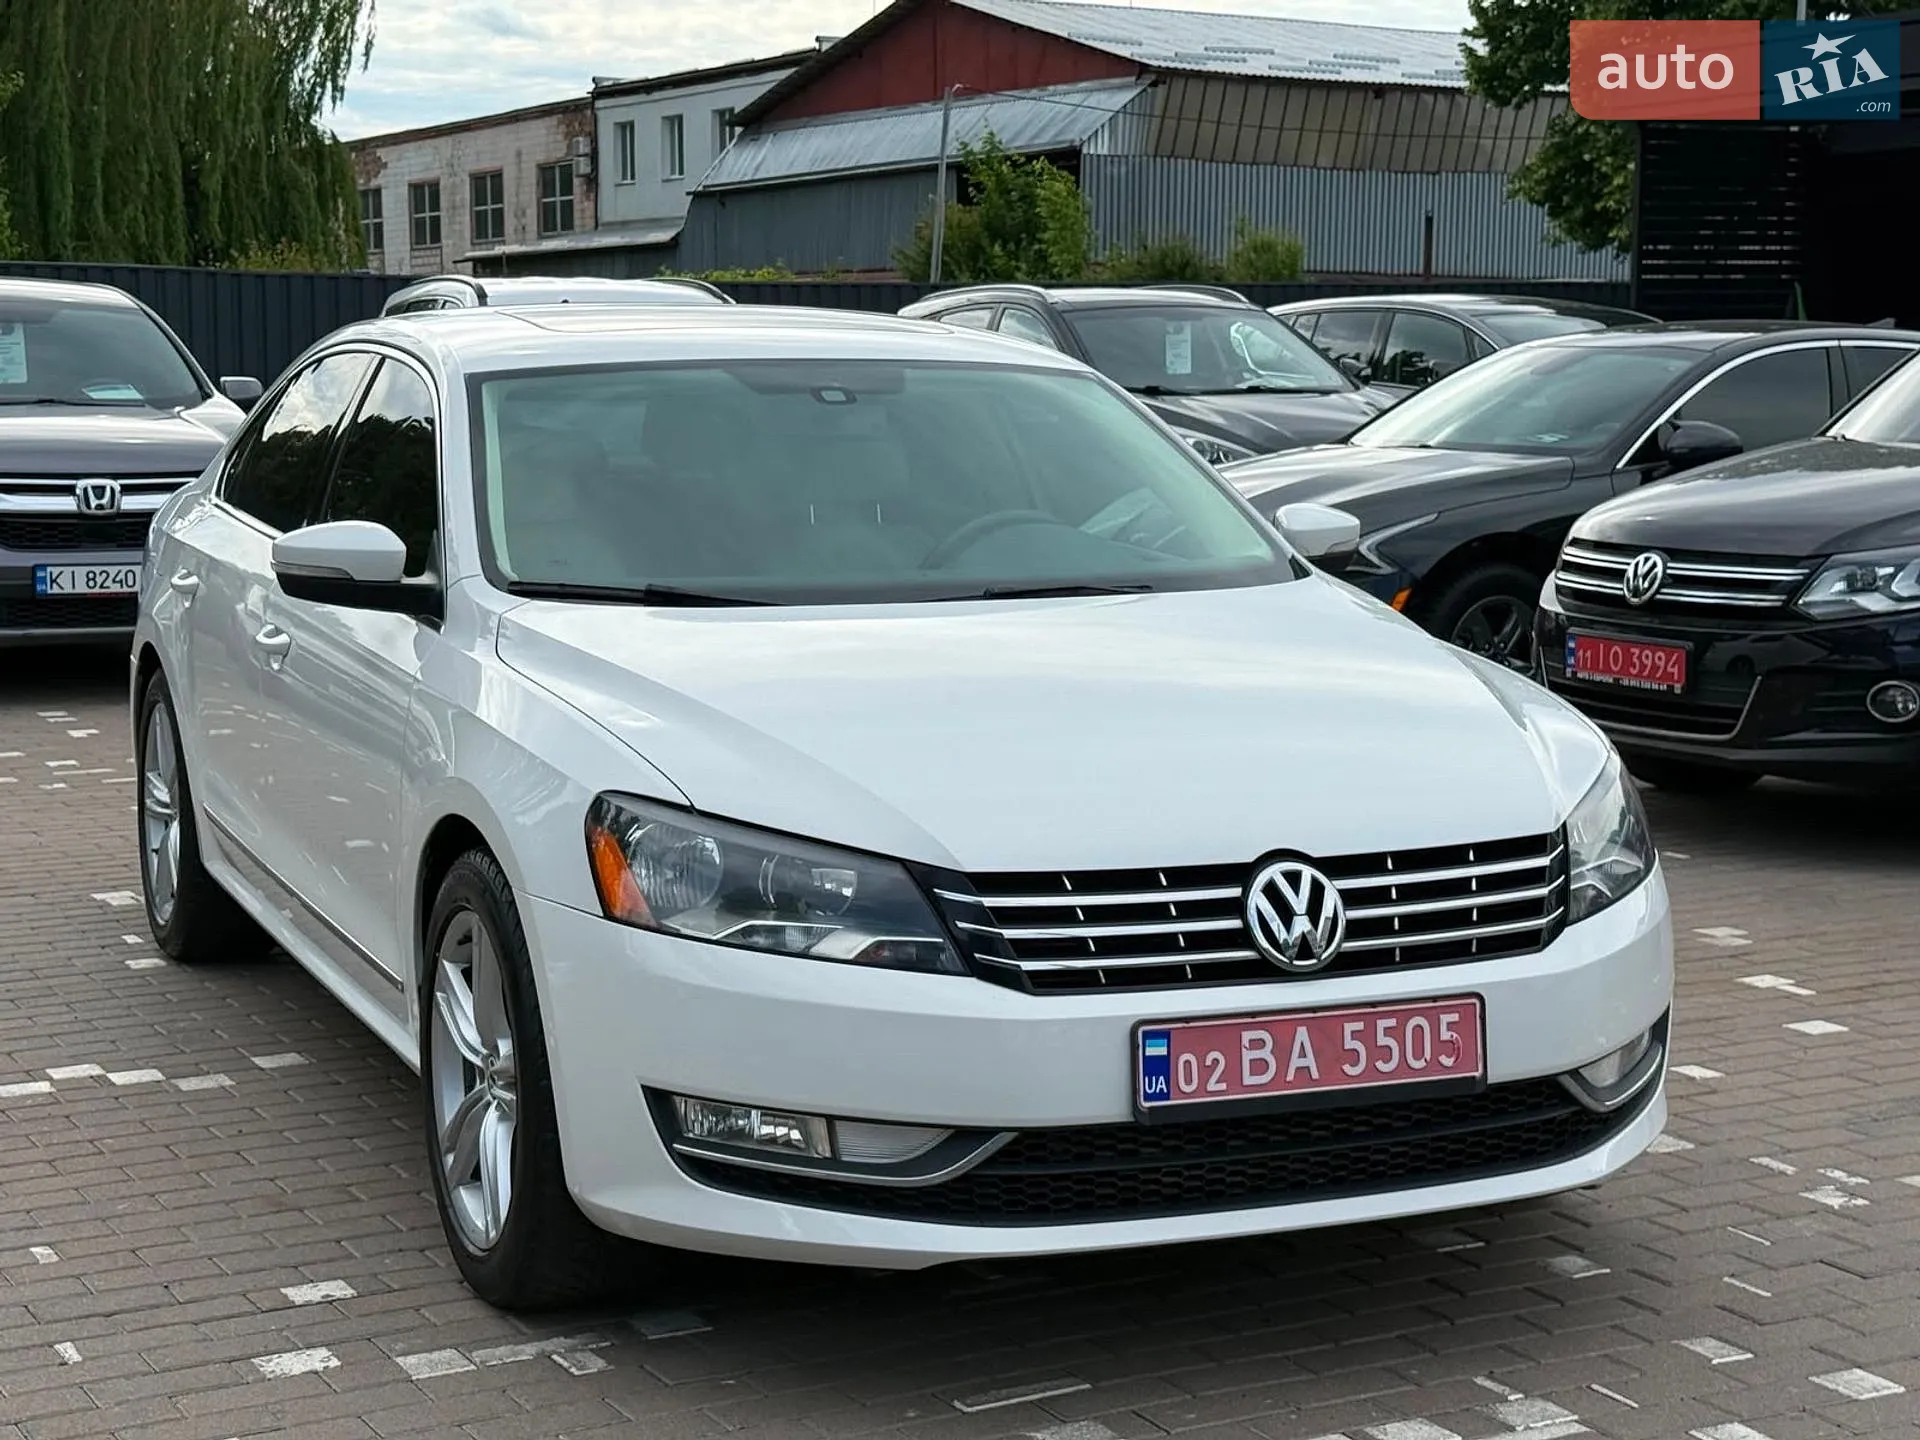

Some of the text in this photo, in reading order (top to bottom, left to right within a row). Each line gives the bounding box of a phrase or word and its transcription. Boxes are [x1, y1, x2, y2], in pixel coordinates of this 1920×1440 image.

[49, 570, 75, 590] KI
[86, 569, 136, 589] 8240
[1577, 648, 1592, 669] 11
[1629, 647, 1679, 681] 3994
[1177, 1012, 1463, 1093] 02 BA 5505
[1144, 1076, 1168, 1094] UA
